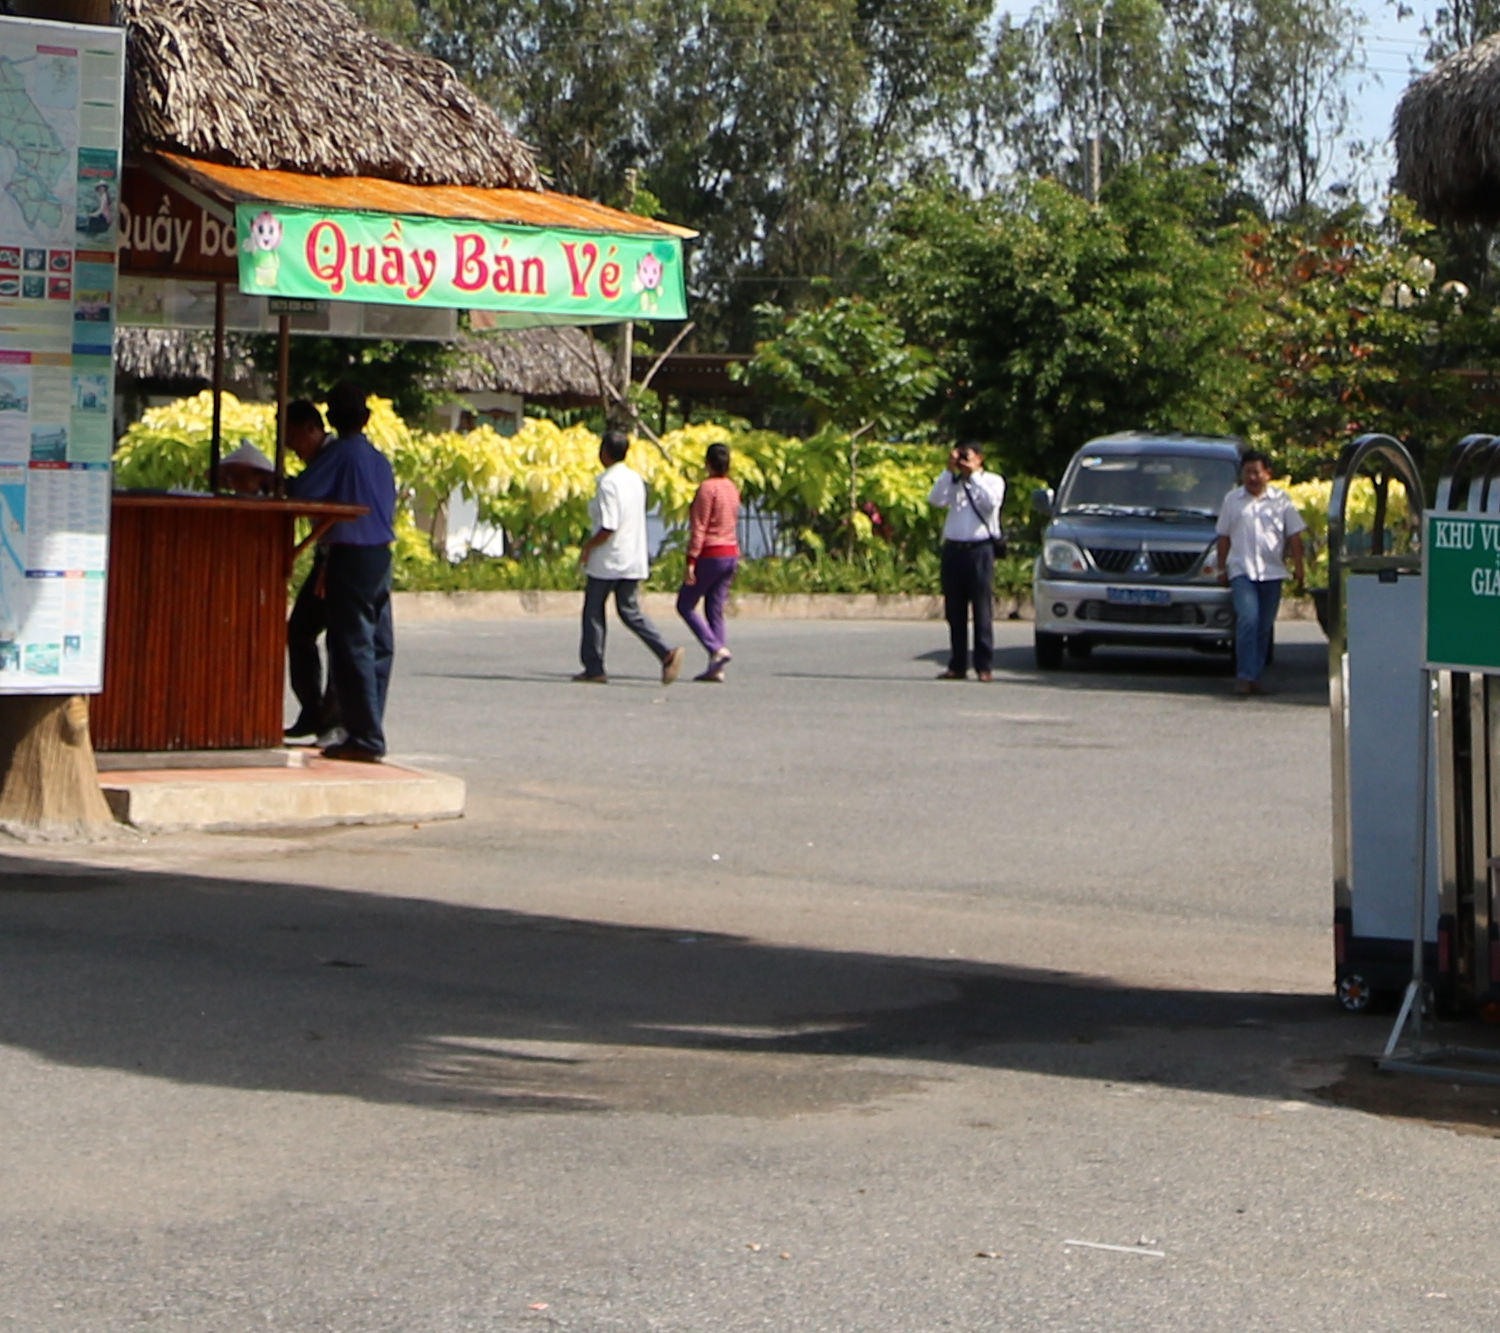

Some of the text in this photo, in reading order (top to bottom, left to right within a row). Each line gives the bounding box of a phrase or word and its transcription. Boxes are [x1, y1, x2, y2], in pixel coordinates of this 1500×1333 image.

[305, 217, 437, 301] Quầy
[452, 233, 546, 297] Bán
[560, 241, 623, 299] Vé
[1435, 520, 1476, 550] KHU
